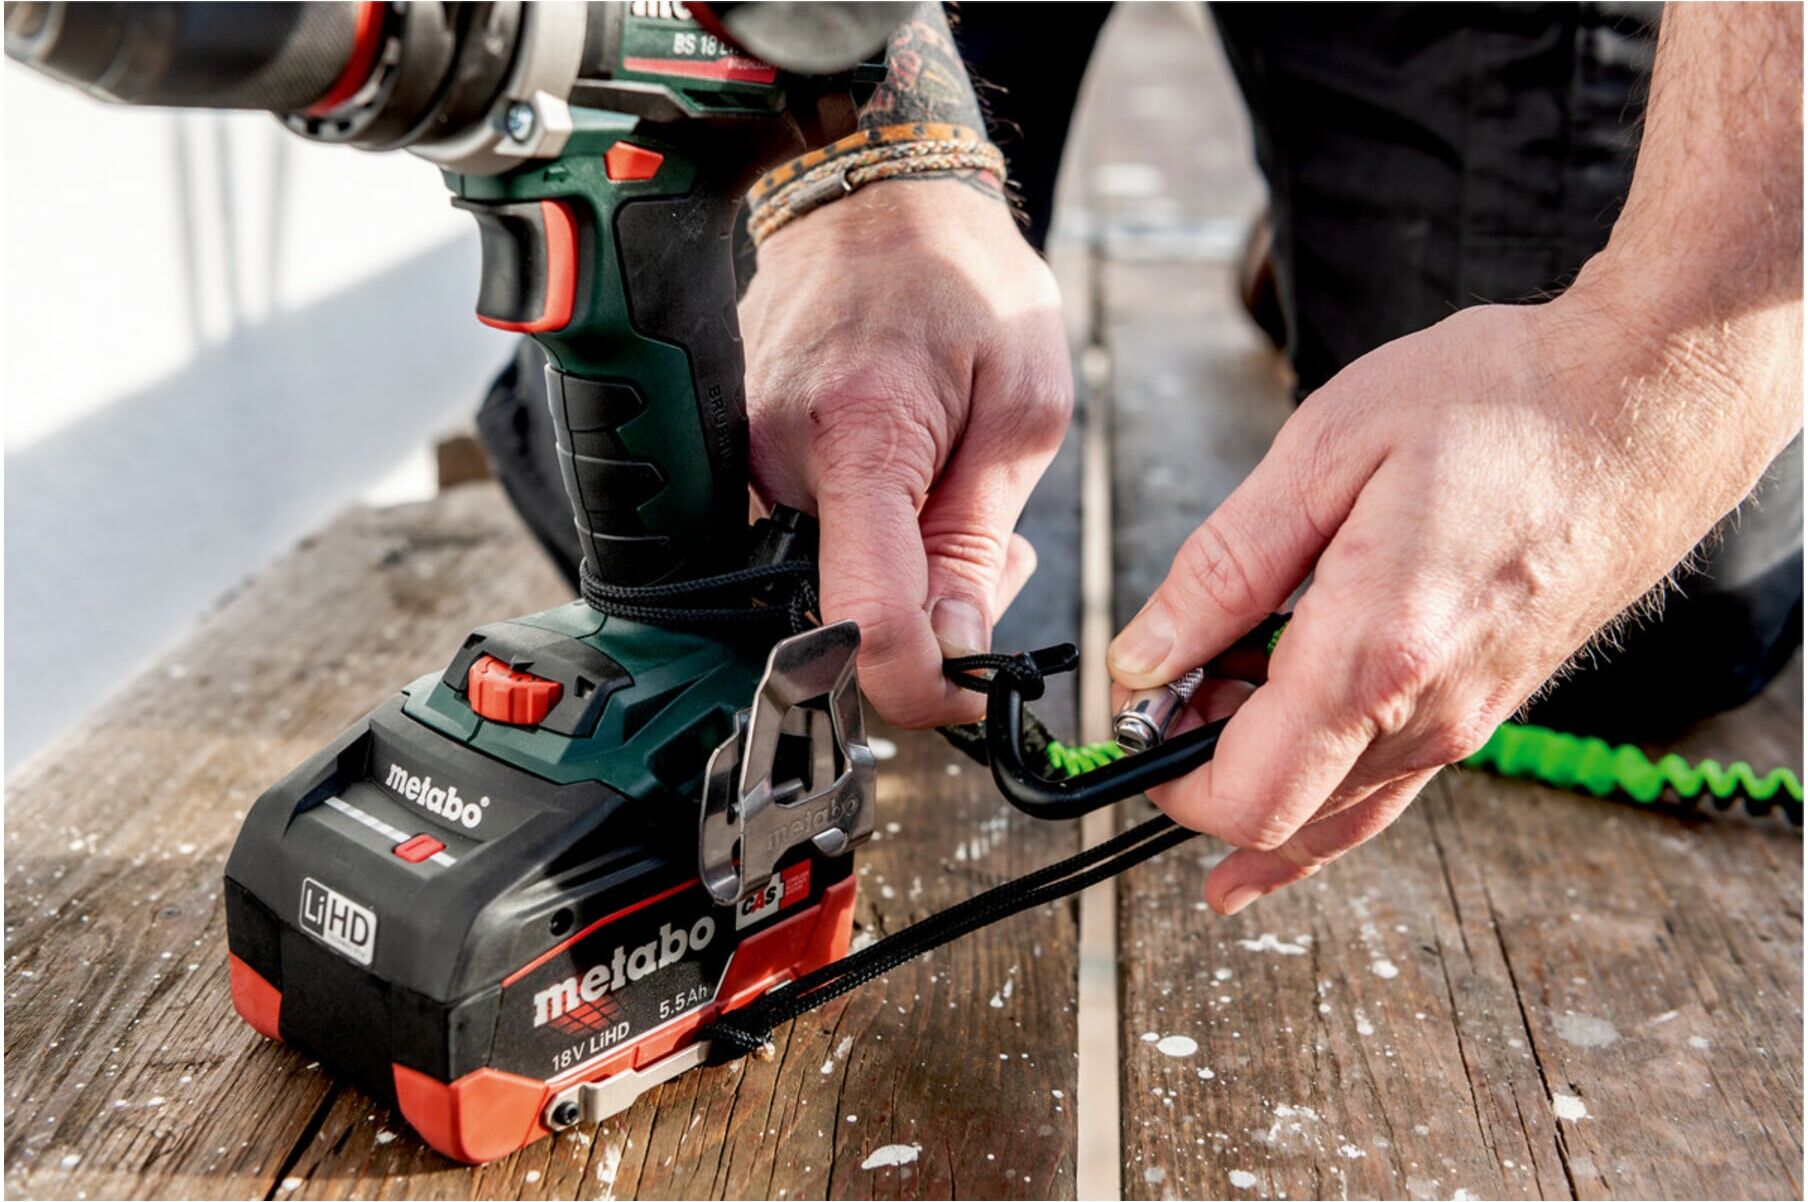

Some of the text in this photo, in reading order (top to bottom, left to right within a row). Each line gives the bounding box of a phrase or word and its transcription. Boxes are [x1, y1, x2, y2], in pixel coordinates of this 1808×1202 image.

[673, 32, 696, 56] BS
[700, 36, 718, 56] 18
[385, 763, 483, 829] metabo
[768, 797, 859, 850] metabo
[304, 888, 370, 947] LiHD
[741, 886, 777, 917] CAS
[533, 915, 716, 1028] metabo
[552, 1021, 630, 1071] 18V LiHD
